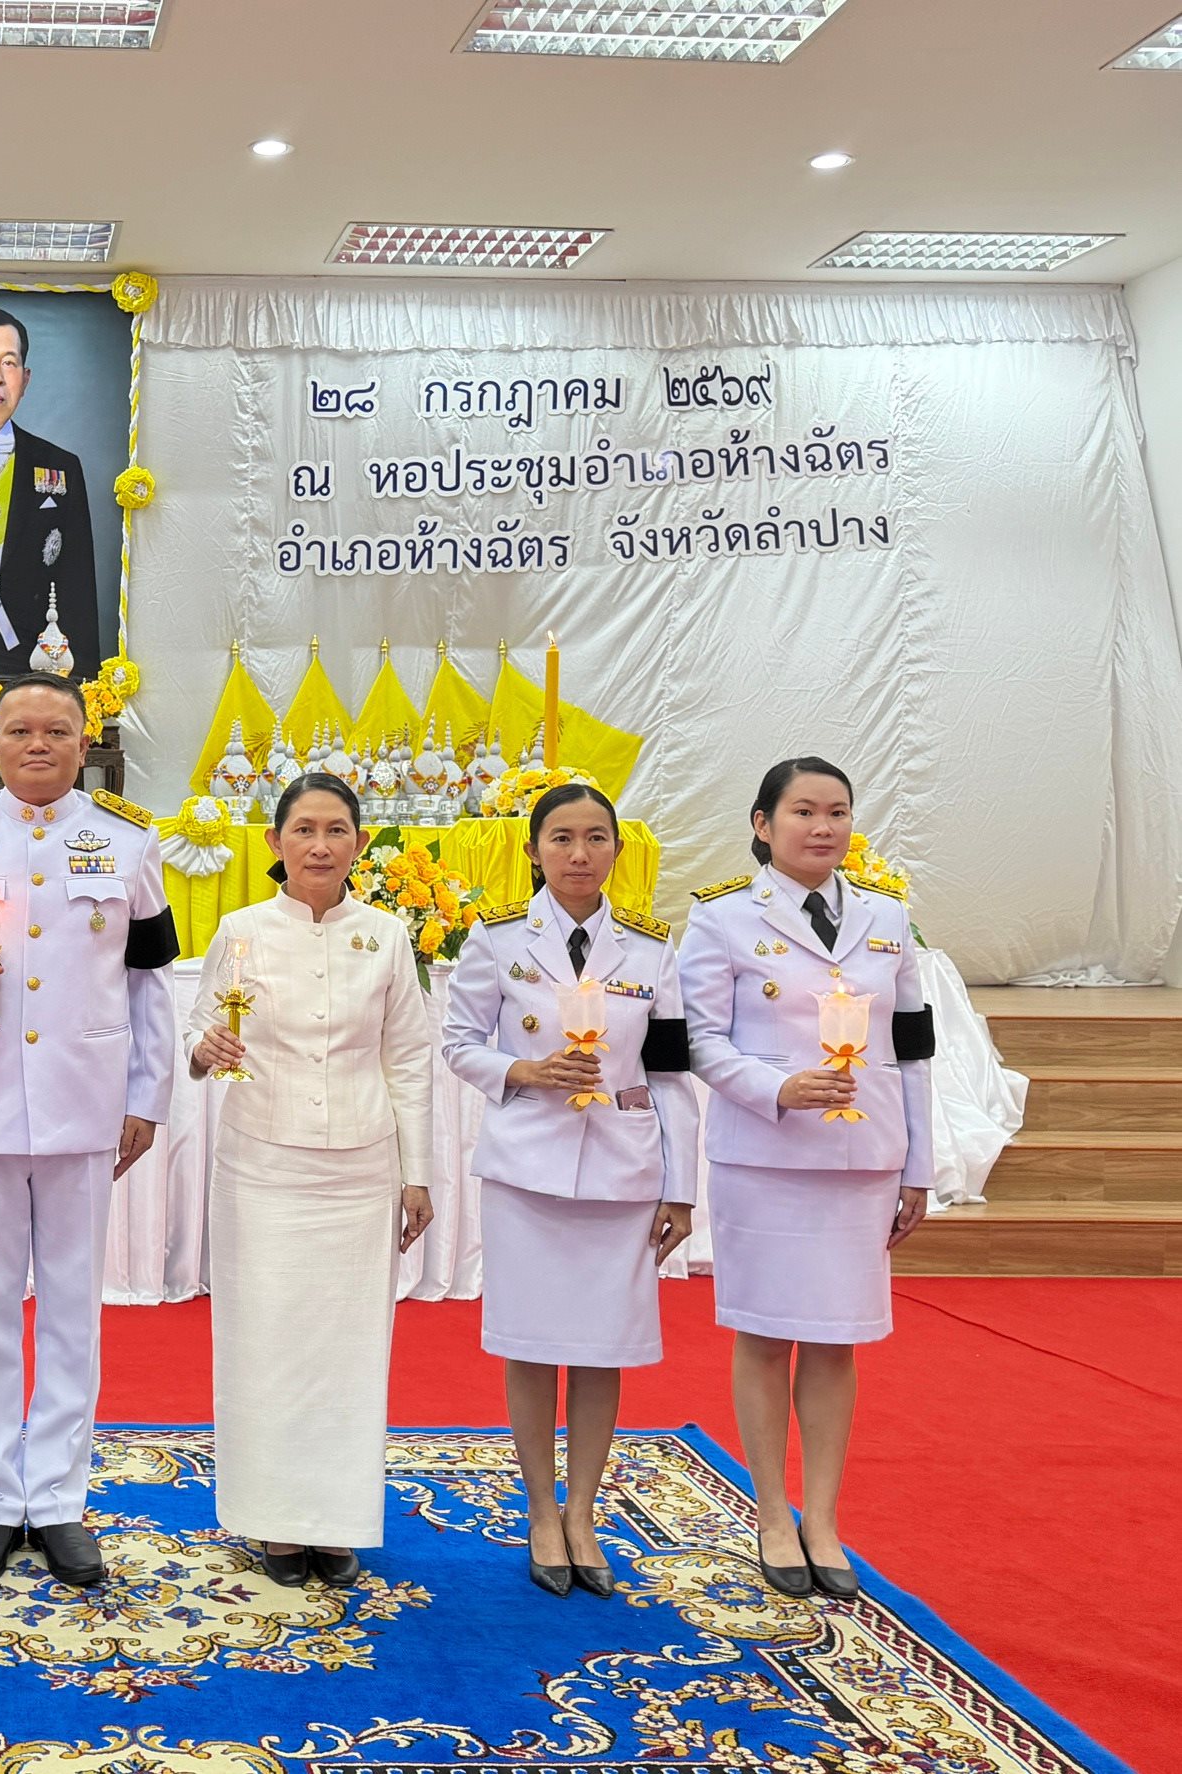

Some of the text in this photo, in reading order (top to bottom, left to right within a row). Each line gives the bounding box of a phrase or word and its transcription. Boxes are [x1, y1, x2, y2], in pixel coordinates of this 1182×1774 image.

[310, 363, 773, 428] ๒๘ กรกฎาคม ๒๕๖๙
[292, 426, 890, 506] ณ หอประชุมอำเภอห้างฉัตร
[277, 506, 890, 573] อำเภอห้างฉัตร จังหวัดลำปาง
